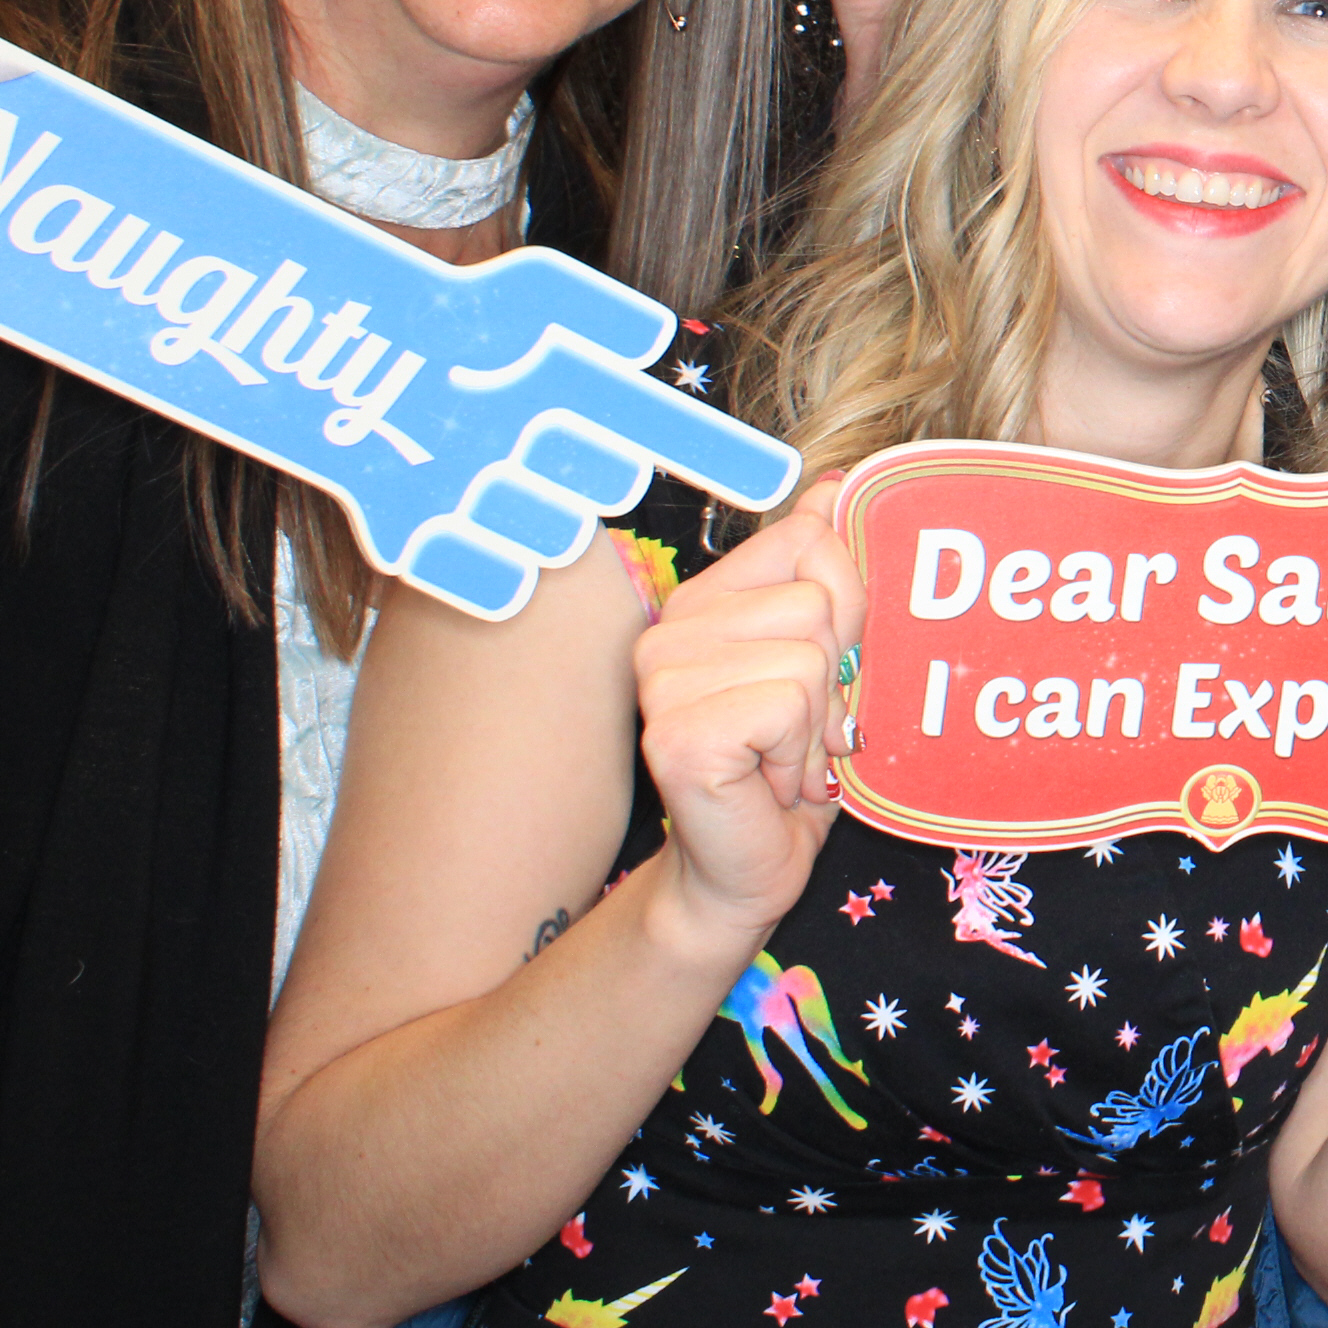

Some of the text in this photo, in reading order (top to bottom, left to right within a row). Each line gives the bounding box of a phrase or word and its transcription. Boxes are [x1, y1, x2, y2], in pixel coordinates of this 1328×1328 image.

[908, 527, 1179, 623] Dear
[920, 658, 951, 738] I
[974, 675, 1145, 740] can
